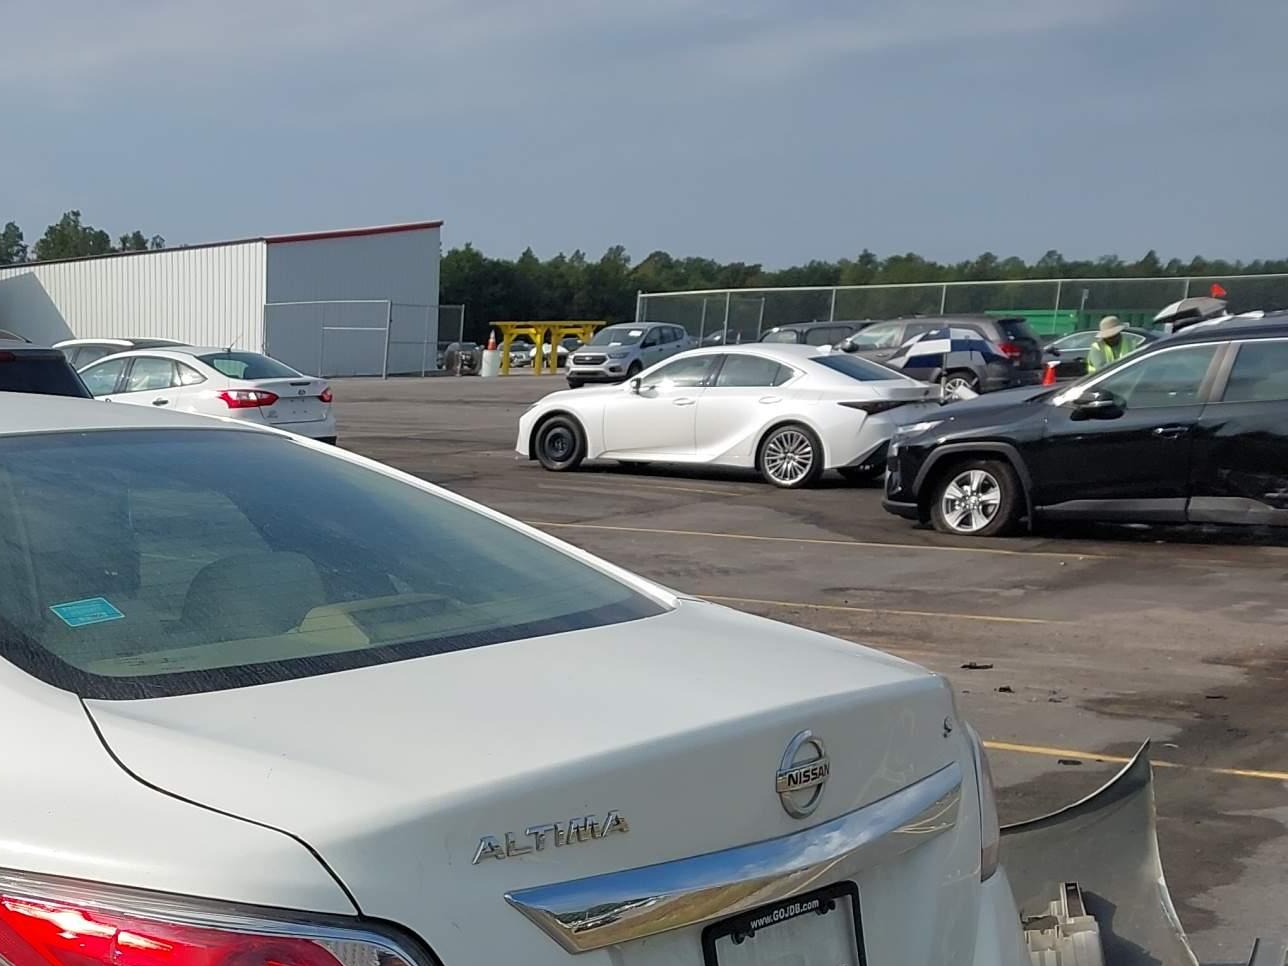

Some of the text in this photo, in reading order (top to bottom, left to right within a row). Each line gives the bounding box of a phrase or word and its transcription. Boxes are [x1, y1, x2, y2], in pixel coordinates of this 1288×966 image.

[787, 761, 830, 787] NISSAN
[472, 809, 630, 865] ALTIMA
[750, 899, 820, 930] www.GOJDB.com
